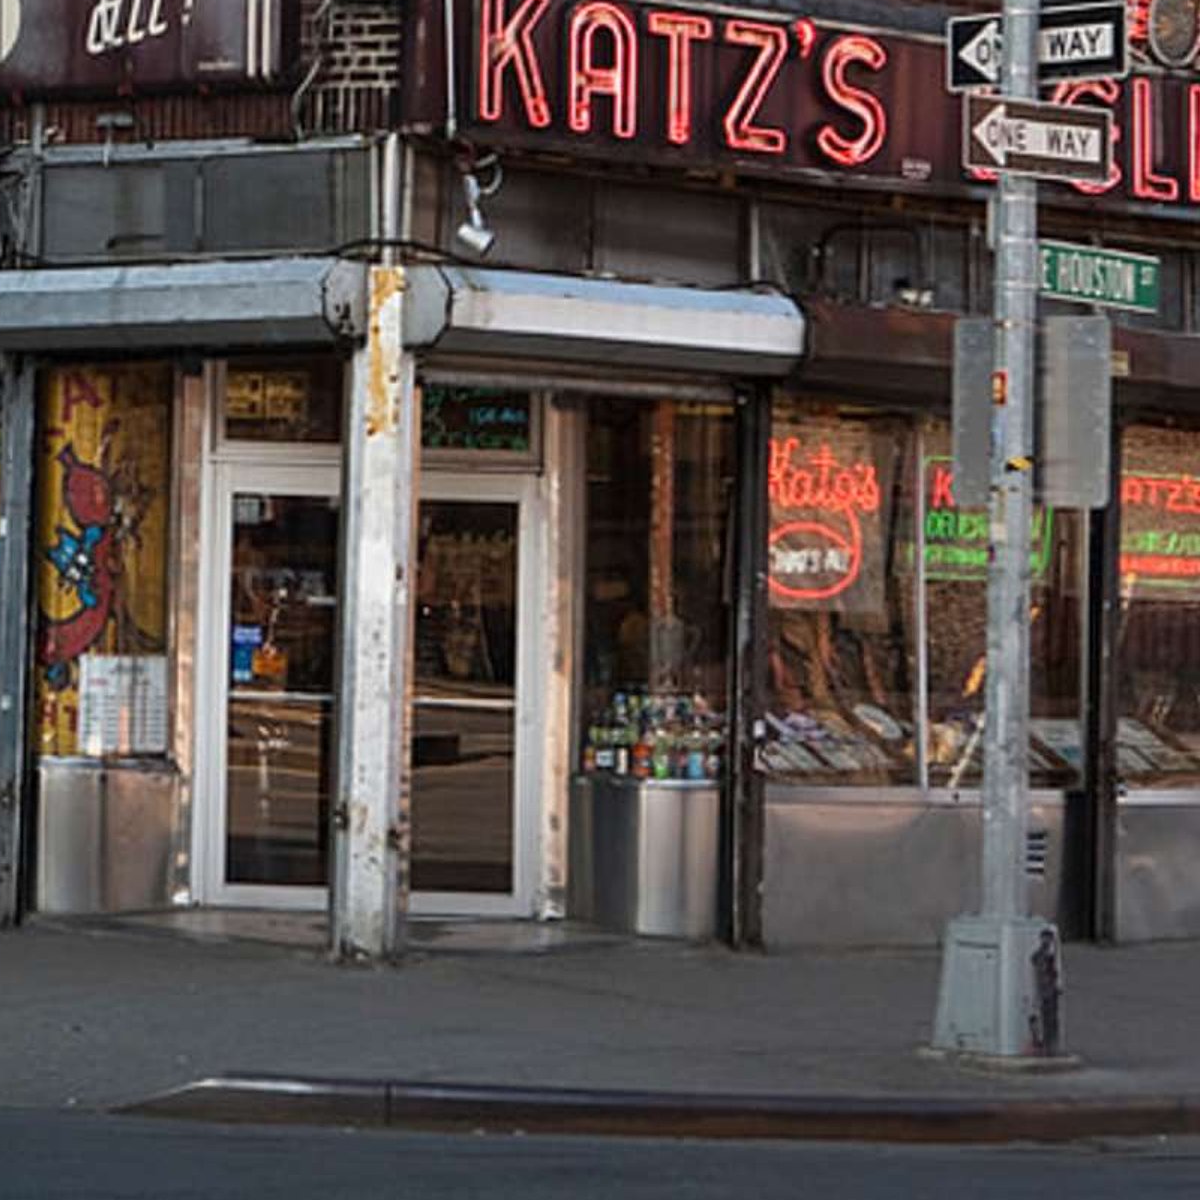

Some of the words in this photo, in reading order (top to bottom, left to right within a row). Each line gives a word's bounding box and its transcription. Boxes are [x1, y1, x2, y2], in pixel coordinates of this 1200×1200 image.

[1049, 27, 1104, 58] WAY
[985, 119, 1027, 150] ONE
[1046, 126, 1093, 156] WAY
[1057, 252, 1136, 302] HOUSTON
